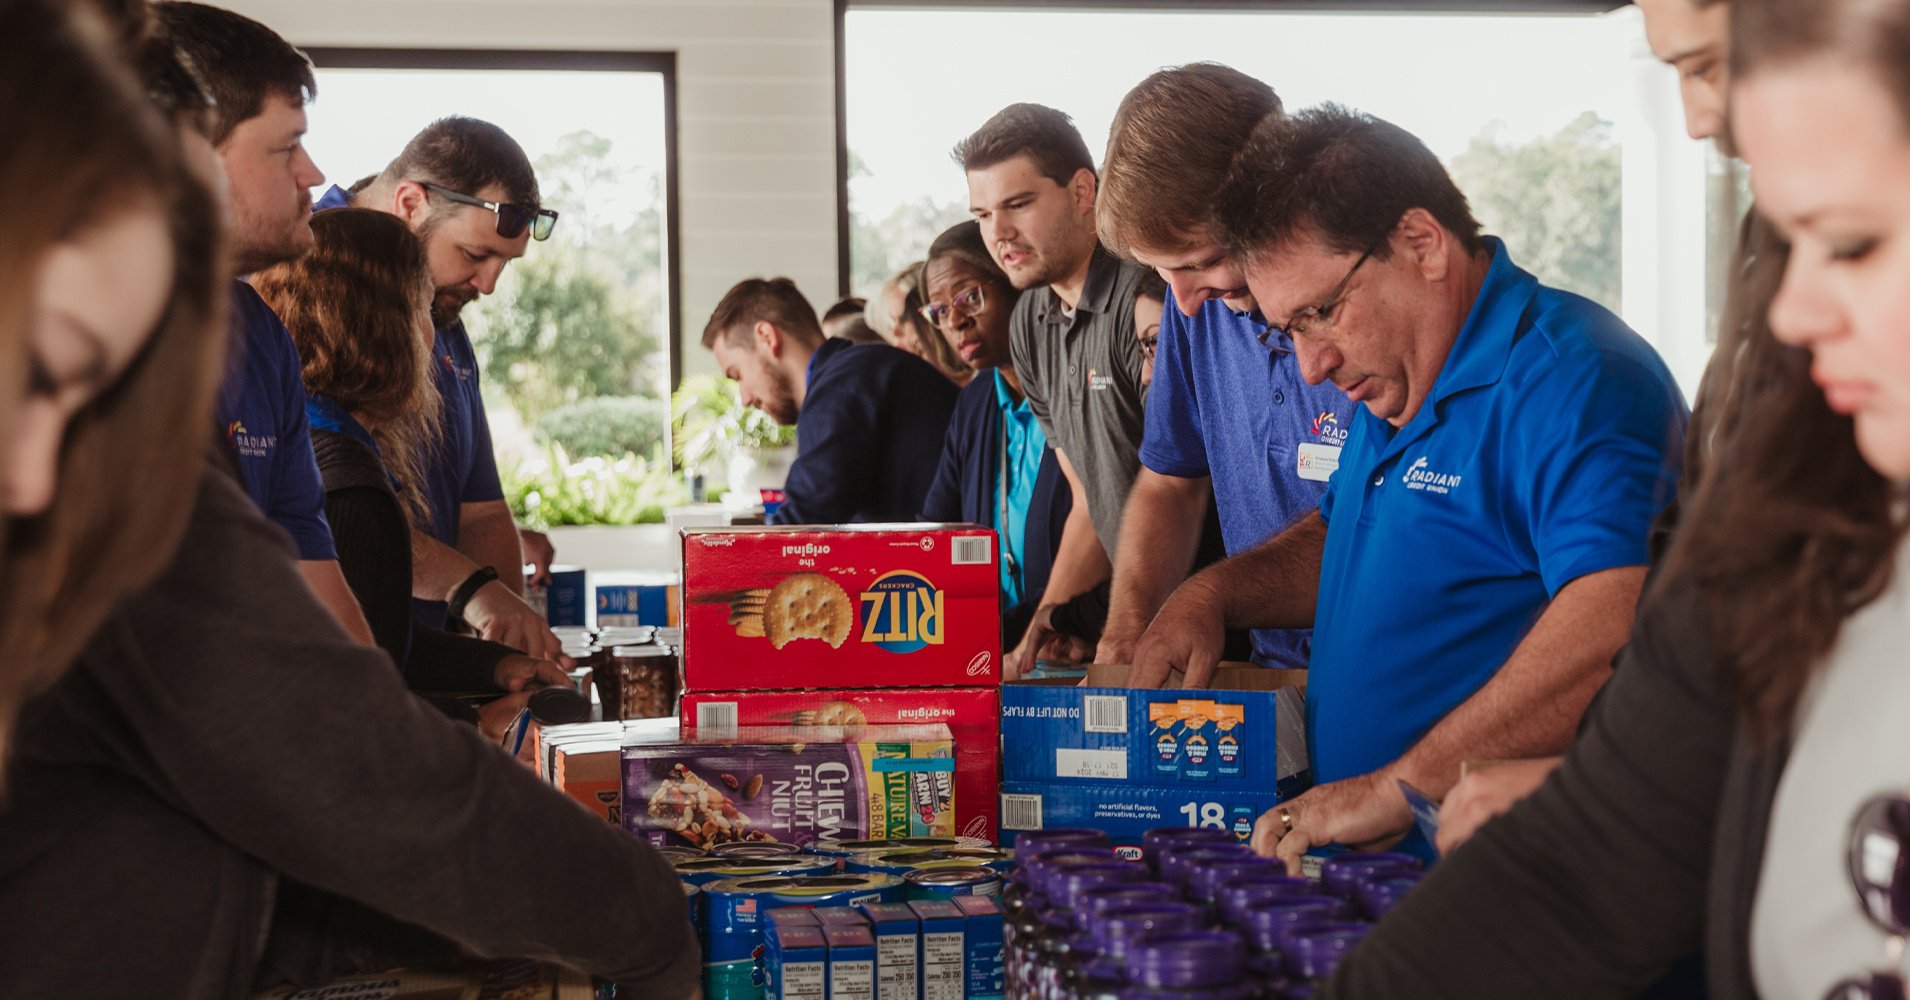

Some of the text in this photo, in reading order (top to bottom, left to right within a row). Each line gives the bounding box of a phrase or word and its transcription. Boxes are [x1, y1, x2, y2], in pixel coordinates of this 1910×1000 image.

[1410, 470, 1461, 487] RADIANT
[783, 543, 830, 557] original
[799, 559, 815, 567] the
[861, 587, 944, 644] RITZ
[898, 708, 955, 720] the original
[1003, 706, 1080, 718] DO NOT LIFT BY FLAPS
[915, 772, 932, 805] ARN
[935, 771, 952, 797] BUY
[792, 765, 814, 831] FRUIT
[771, 780, 792, 833] NUT
[1135, 803, 1157, 812] flavors,
[871, 792, 884, 838] 48 BAR
[1094, 811, 1137, 819] preservatives,
[1146, 812, 1160, 820] dyes
[1180, 802, 1226, 829] 18
[896, 973, 905, 981] 250
[906, 972, 914, 980] 350
[943, 971, 951, 979] 250
